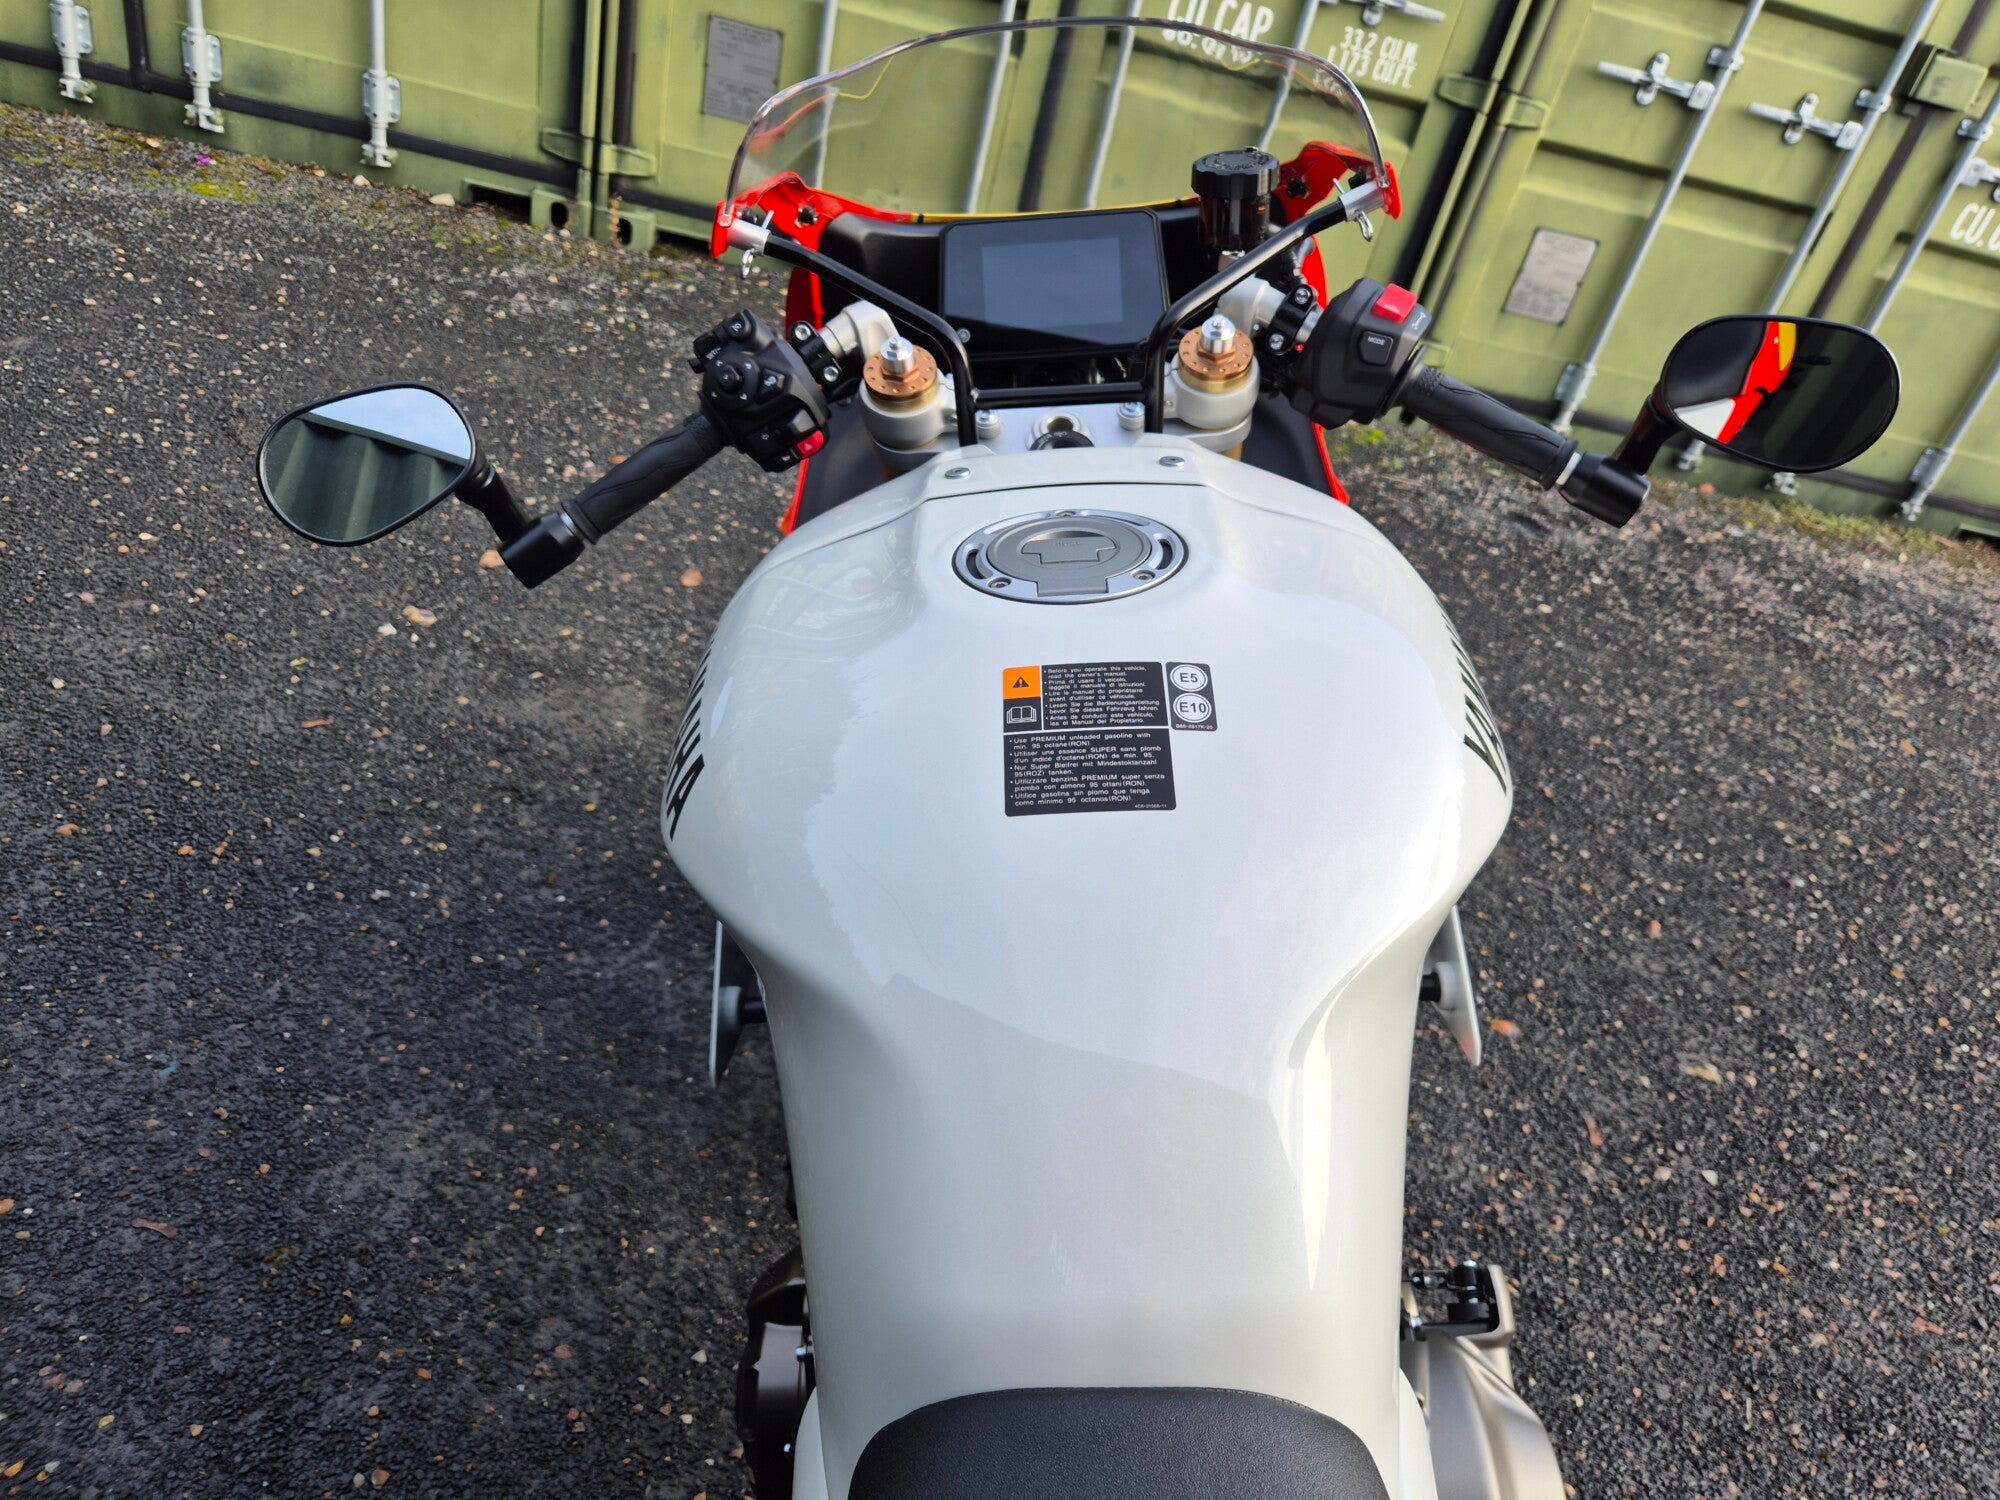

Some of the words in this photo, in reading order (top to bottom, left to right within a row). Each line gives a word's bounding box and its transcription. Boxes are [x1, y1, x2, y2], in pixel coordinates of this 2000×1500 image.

[1368, 336, 1386, 346] MODE
[1180, 672, 1198, 683] E5
[1180, 702, 1206, 713] E10
